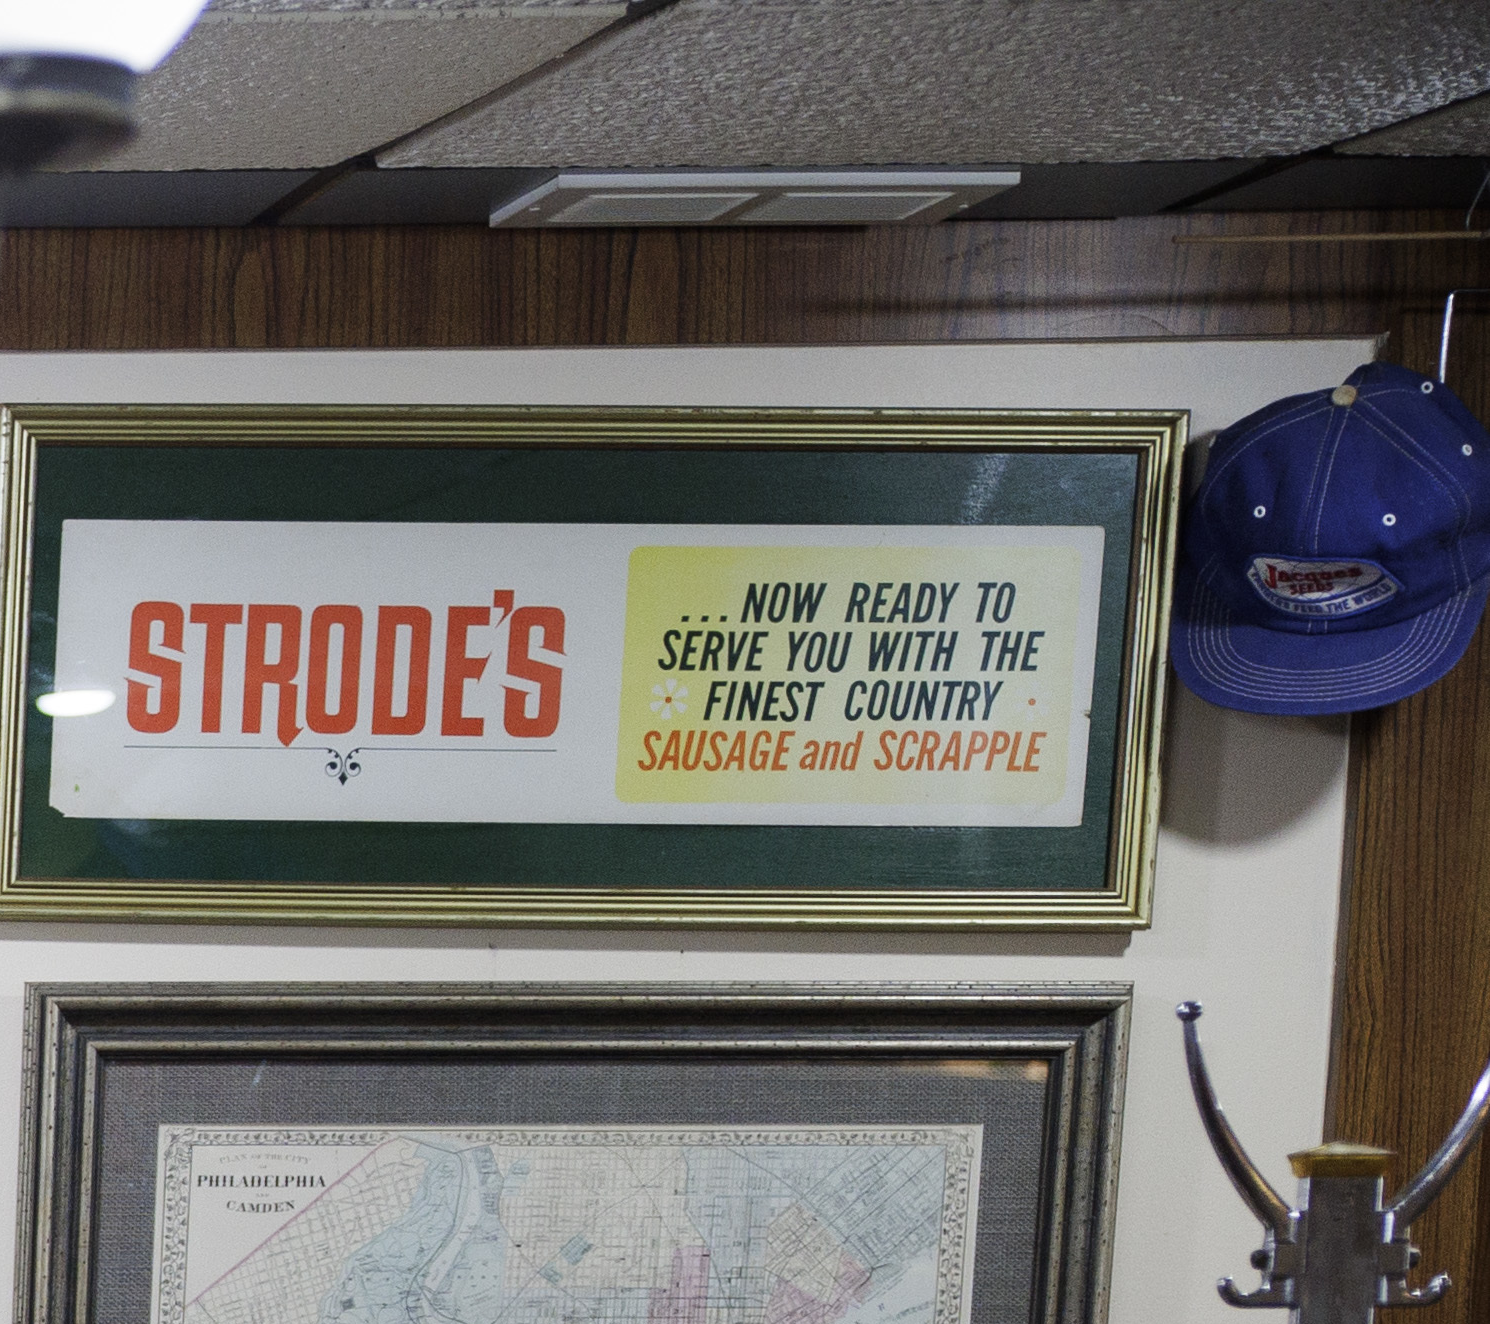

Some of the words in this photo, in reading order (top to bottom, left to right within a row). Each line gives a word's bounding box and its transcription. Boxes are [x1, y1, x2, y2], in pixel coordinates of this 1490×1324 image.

[844, 583, 960, 626] READY
[976, 583, 1016, 626] TO
[1289, 582, 1334, 595] SEEDS
[1325, 599, 1350, 614] THE
[1352, 582, 1393, 605] WORLD
[124, 589, 567, 748] STRODE'S
[658, 631, 763, 671] SERVE
[785, 631, 852, 672] YOU
[868, 631, 955, 673] WITH
[978, 633, 1044, 673] THE
[703, 680, 818, 723] FINEST
[844, 681, 1002, 723] COUNTRY
[637, 729, 790, 773] SAUSAGE
[798, 731, 858, 773] and
[873, 730, 1048, 773] SCRAPPLE
[196, 1174, 327, 1189] PHILADELPHIA
[226, 1200, 296, 1214] CAMDEN
